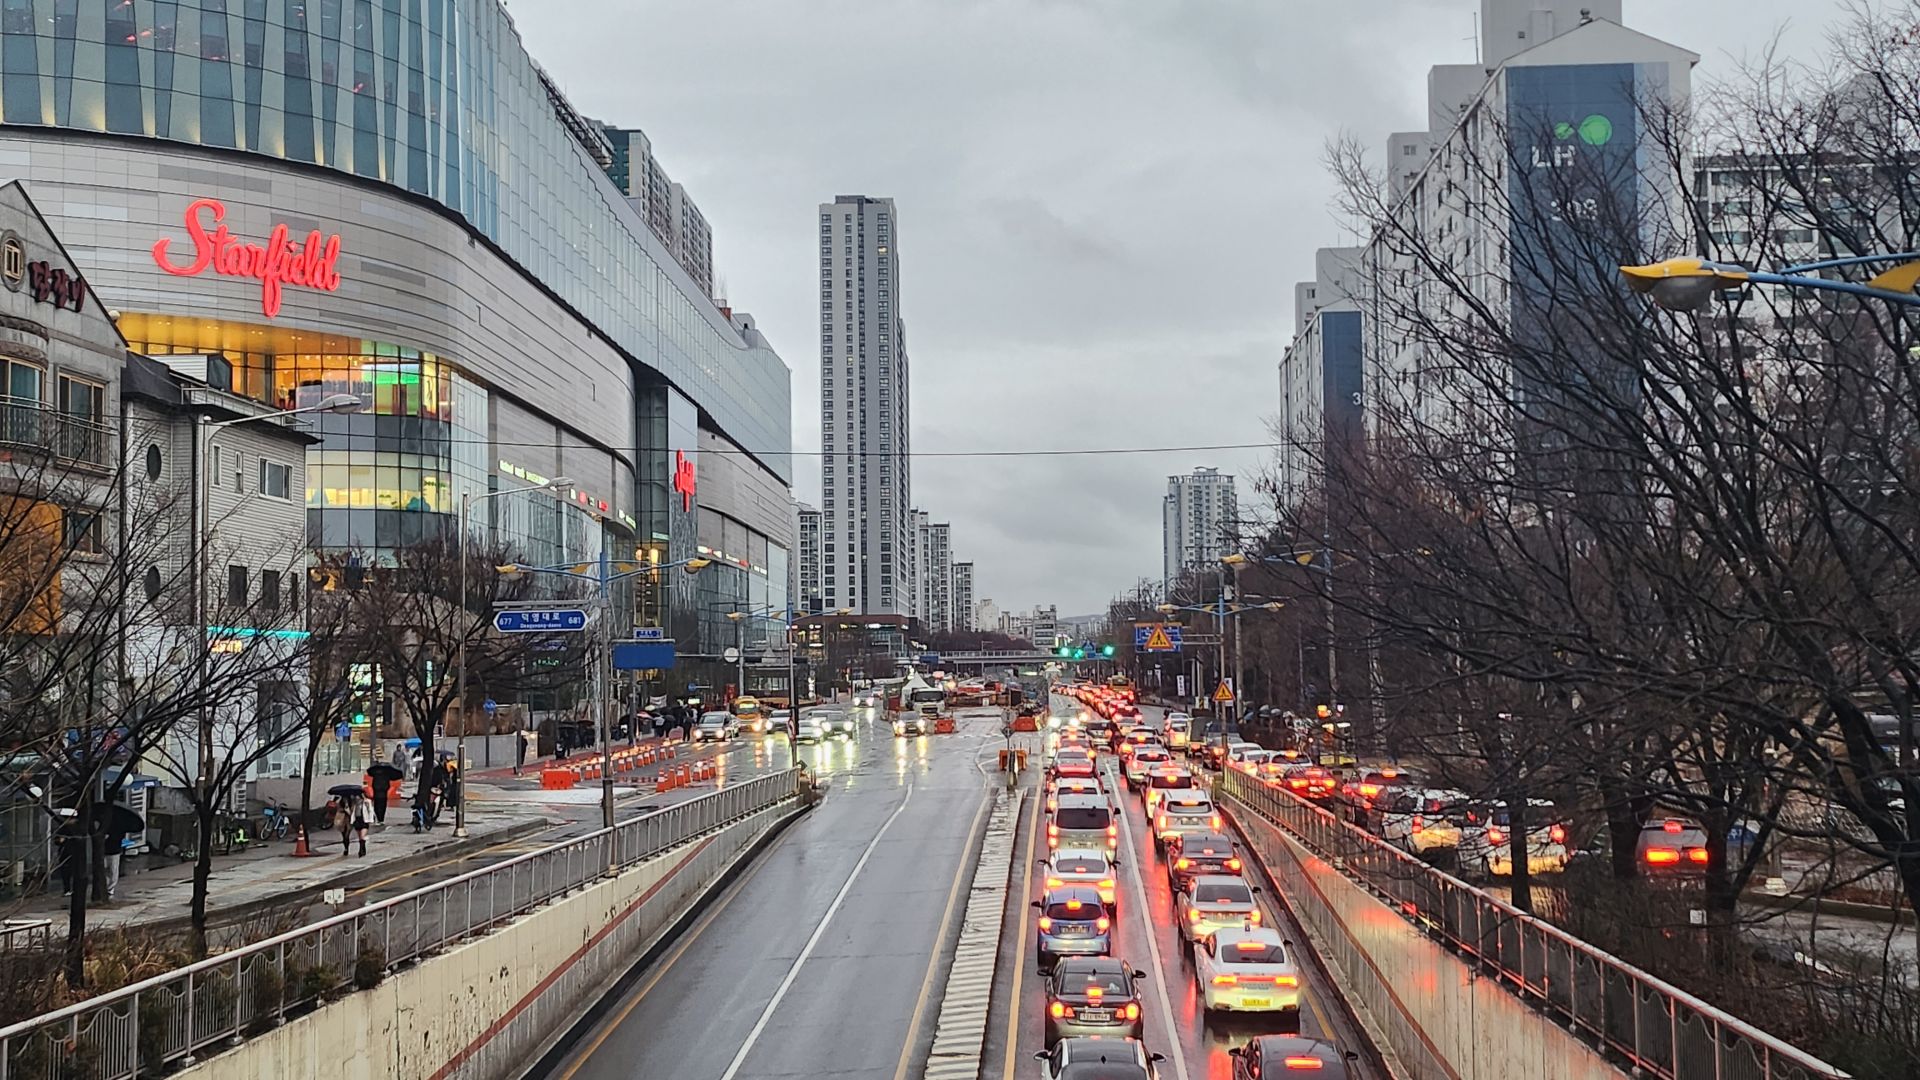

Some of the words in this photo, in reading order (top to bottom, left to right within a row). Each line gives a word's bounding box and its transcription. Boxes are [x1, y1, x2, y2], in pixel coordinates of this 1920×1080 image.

[1532, 145, 1576, 167] LH
[152, 198, 341, 318] Starfield
[499, 617, 512, 625] 677
[521, 612, 560, 622] 덕영대로
